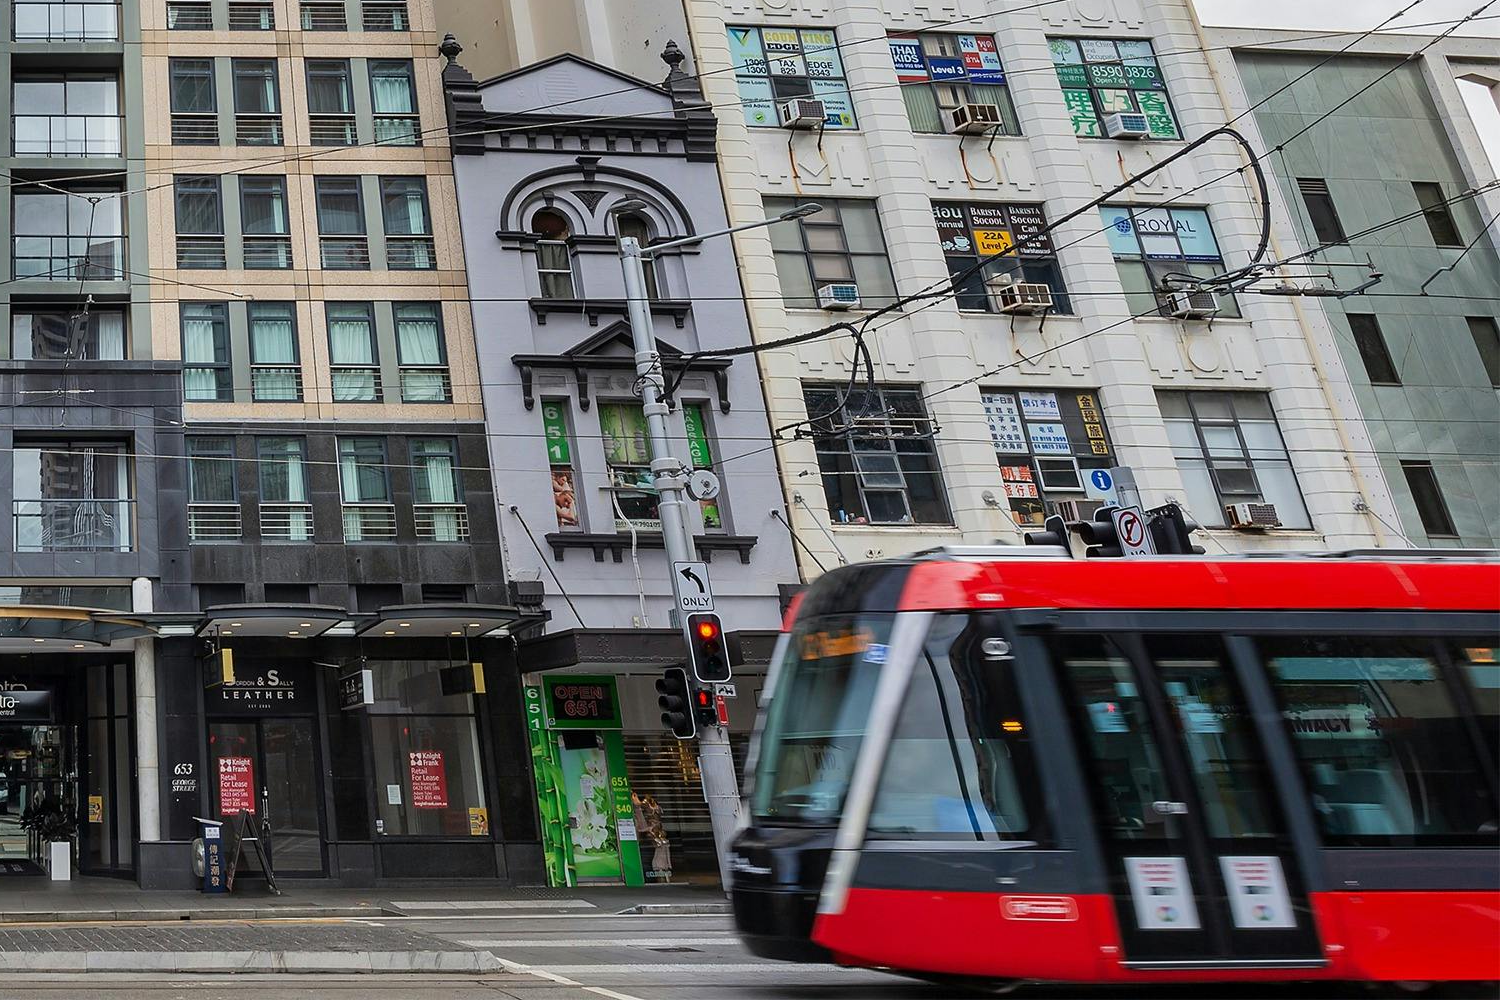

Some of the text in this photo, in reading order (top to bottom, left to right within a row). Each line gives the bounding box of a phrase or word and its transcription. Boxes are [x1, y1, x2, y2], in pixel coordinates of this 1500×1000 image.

[890, 46, 916, 55] THAI
[894, 54, 919, 63] KIDS
[808, 61, 834, 69] EDGE
[746, 66, 767, 74] 1300
[931, 66, 956, 74] Level
[1092, 66, 1122, 78] 8590
[1124, 67, 1155, 78] 0826
[970, 207, 1002, 217] BARISTA
[1009, 206, 1040, 215] BARISTA
[973, 216, 1004, 225] SOCOOL
[1011, 215, 1043, 225] SOCOOL
[1022, 225, 1038, 233] Call
[1136, 219, 1196, 233] ROYAL
[983, 232, 1004, 240] 22A
[982, 242, 1001, 250] Level
[544, 407, 561, 459] 651
[682, 597, 710, 607] ONLY
[257, 676, 265, 686] &
[223, 691, 295, 699] LEATHER
[555, 685, 603, 699] OPEN
[526, 688, 541, 729] 651
[564, 700, 598, 716] 651
[422, 752, 441, 760] Knight
[231, 759, 250, 767] Knight
[174, 763, 193, 775] 653
[411, 767, 428, 775] Retail
[612, 777, 628, 786] 651
[616, 805, 632, 813] $40
